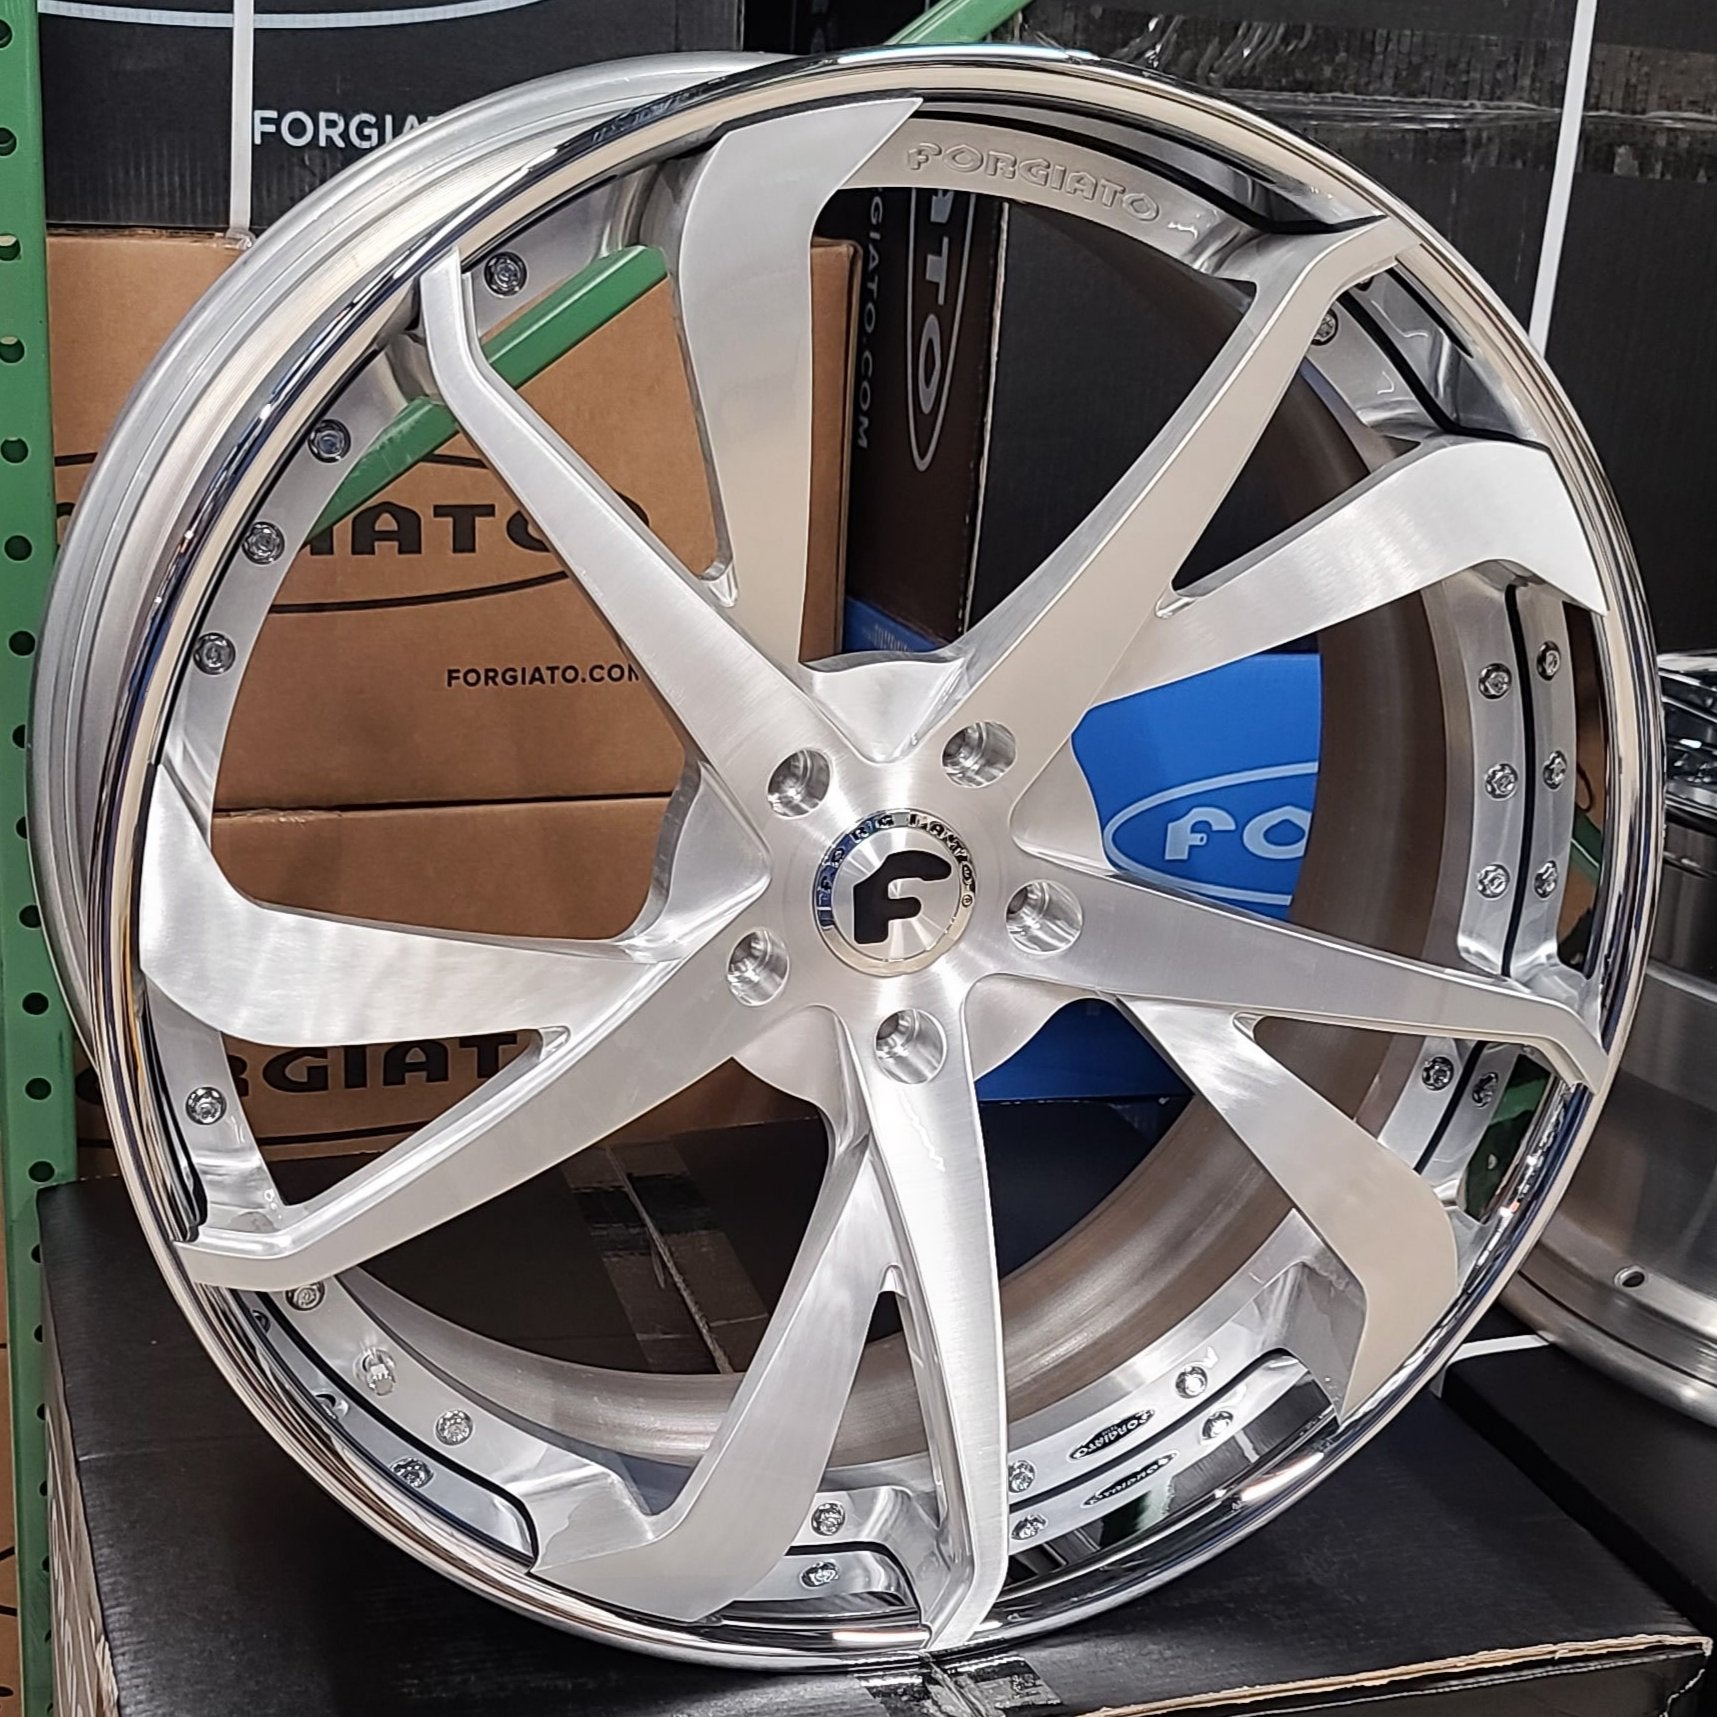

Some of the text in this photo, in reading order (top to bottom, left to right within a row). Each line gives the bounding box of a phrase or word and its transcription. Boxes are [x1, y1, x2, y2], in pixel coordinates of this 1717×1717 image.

[253, 110, 438, 149] FORGIA
[907, 142, 1160, 221] FORGIATO
[857, 188, 884, 449] GIATO.COM
